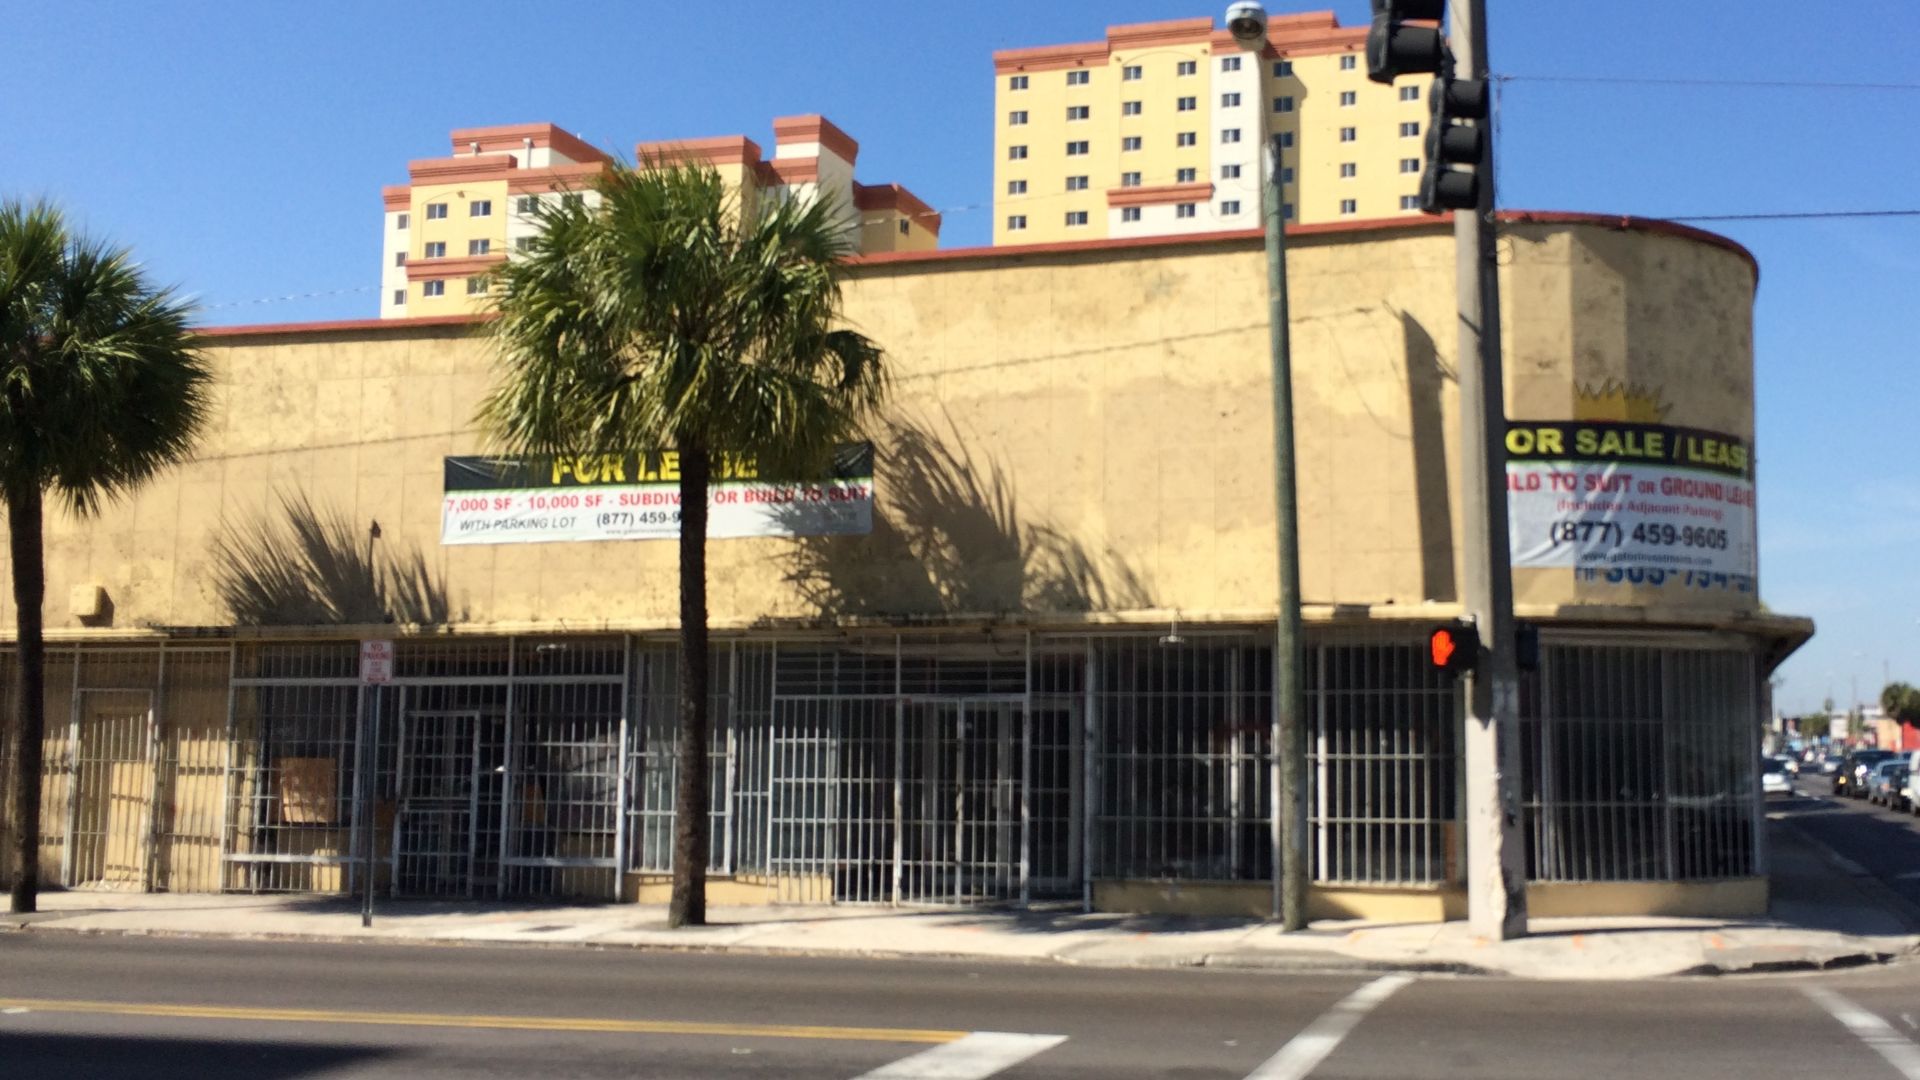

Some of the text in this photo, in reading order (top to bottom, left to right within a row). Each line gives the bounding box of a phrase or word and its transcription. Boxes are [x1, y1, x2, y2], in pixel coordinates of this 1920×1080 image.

[1505, 427, 1564, 455] OR
[1575, 428, 1664, 457] SALE
[1687, 436, 1748, 470] LEAS
[1548, 472, 1577, 491] TO
[1584, 473, 1632, 493] SUIT
[1661, 477, 1723, 501] GROUND
[447, 498, 488, 513] 7,000
[494, 497, 512, 510] SF
[528, 495, 579, 510] 10,000
[585, 494, 603, 507] SF
[619, 493, 682, 506] SUBDIV
[714, 490, 737, 503] OR
[744, 489, 794, 504] BUILD
[493, 518, 551, 530] PARKING
[552, 516, 576, 529] LOT
[597, 512, 634, 528] (877)
[1550, 521, 1728, 550] (877) 459-9605
